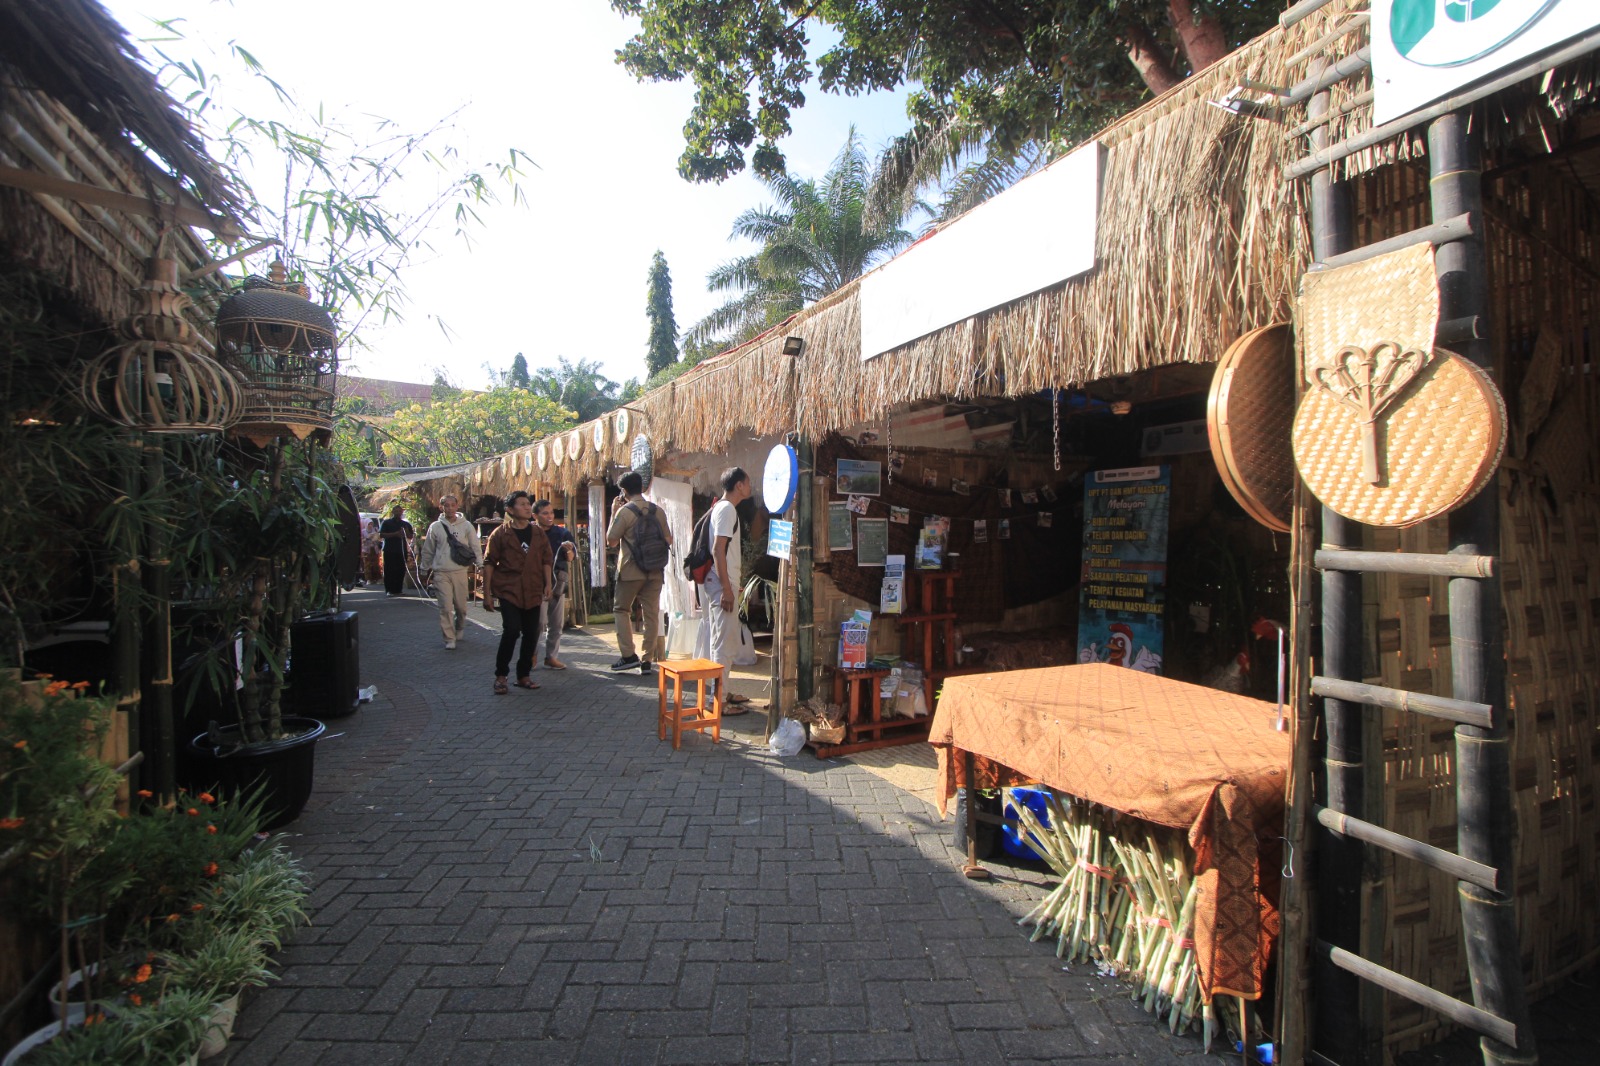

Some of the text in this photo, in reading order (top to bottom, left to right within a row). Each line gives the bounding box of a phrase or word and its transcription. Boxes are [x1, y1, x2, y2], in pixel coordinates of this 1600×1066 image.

[1107, 499, 1146, 511] Melayani
[1092, 517, 1126, 526] BIBIT AYAM
[1092, 531, 1147, 540] TELUR DAN DAGING
[1091, 544, 1112, 554] PULLET
[1090, 573, 1148, 584] SARANA PELATIHAN
[1090, 586, 1145, 598] TEMPAT KEGIATAN
[1088, 598, 1124, 611] PELAYANAN
